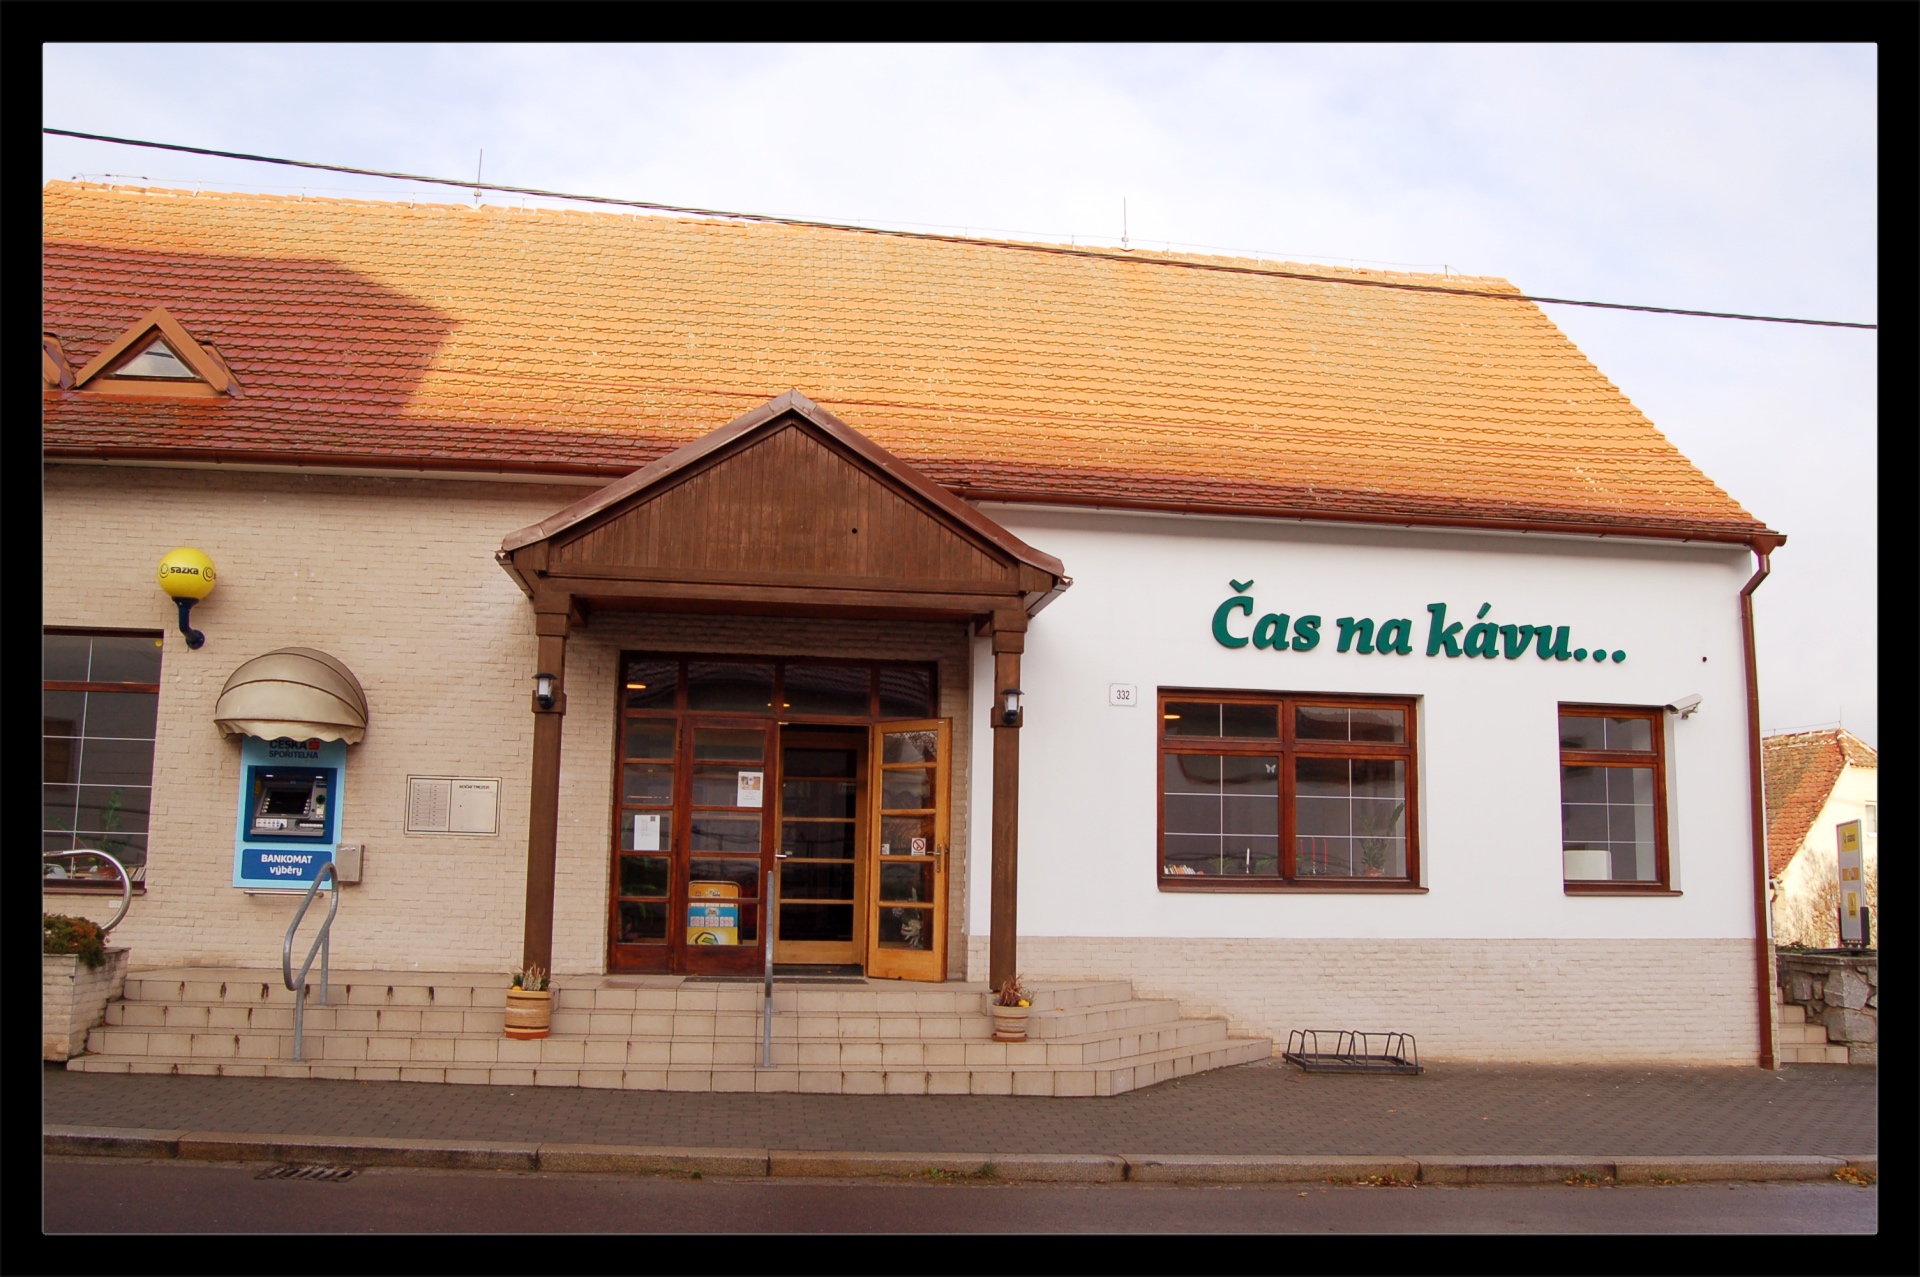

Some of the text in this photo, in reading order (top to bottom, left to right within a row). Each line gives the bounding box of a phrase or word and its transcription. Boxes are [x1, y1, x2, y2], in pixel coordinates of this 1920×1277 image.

[1211, 578, 1627, 664] Čas na kávu...
[1116, 689, 1130, 700] 332
[268, 748, 319, 760] SPOŘITELNA
[261, 853, 313, 864] BANKOMAT
[269, 865, 303, 876] výběry
